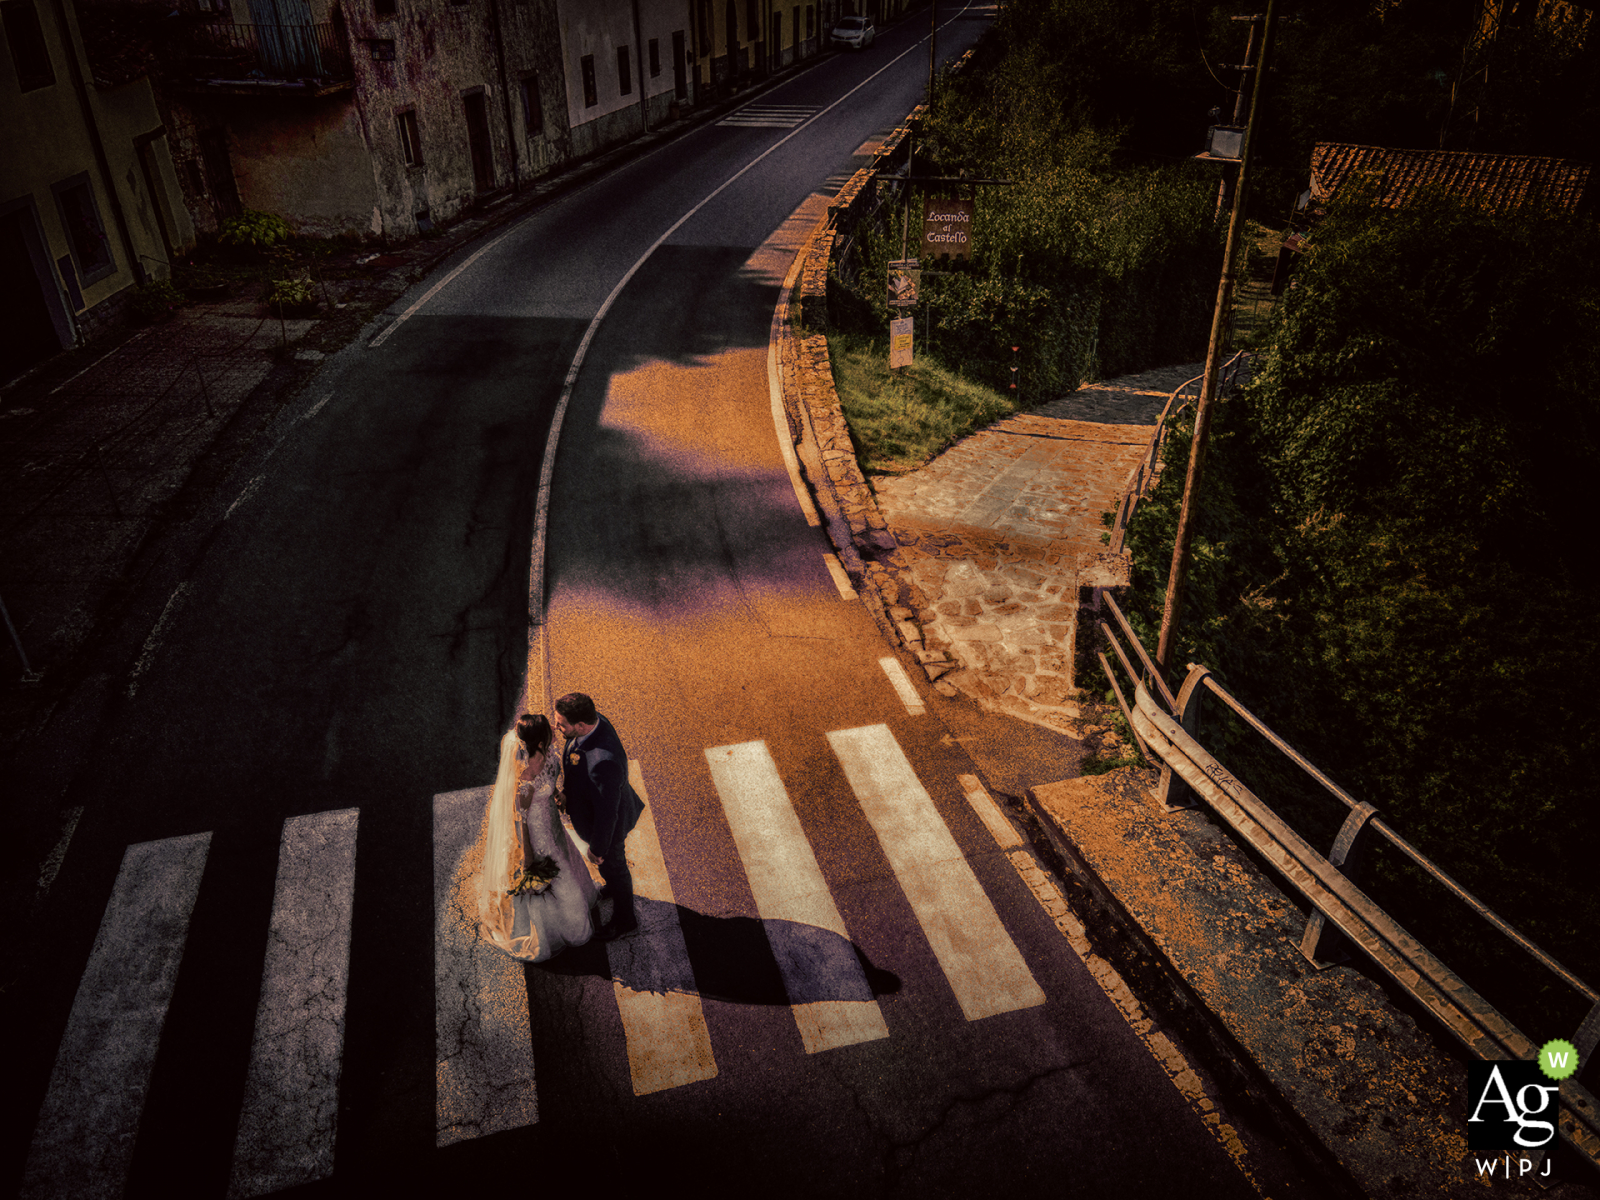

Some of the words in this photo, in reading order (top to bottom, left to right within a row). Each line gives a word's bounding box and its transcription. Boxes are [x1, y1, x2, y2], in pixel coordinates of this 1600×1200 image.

[926, 211, 970, 223] Locanda
[942, 223, 953, 232] al
[926, 231, 968, 244] Castello
